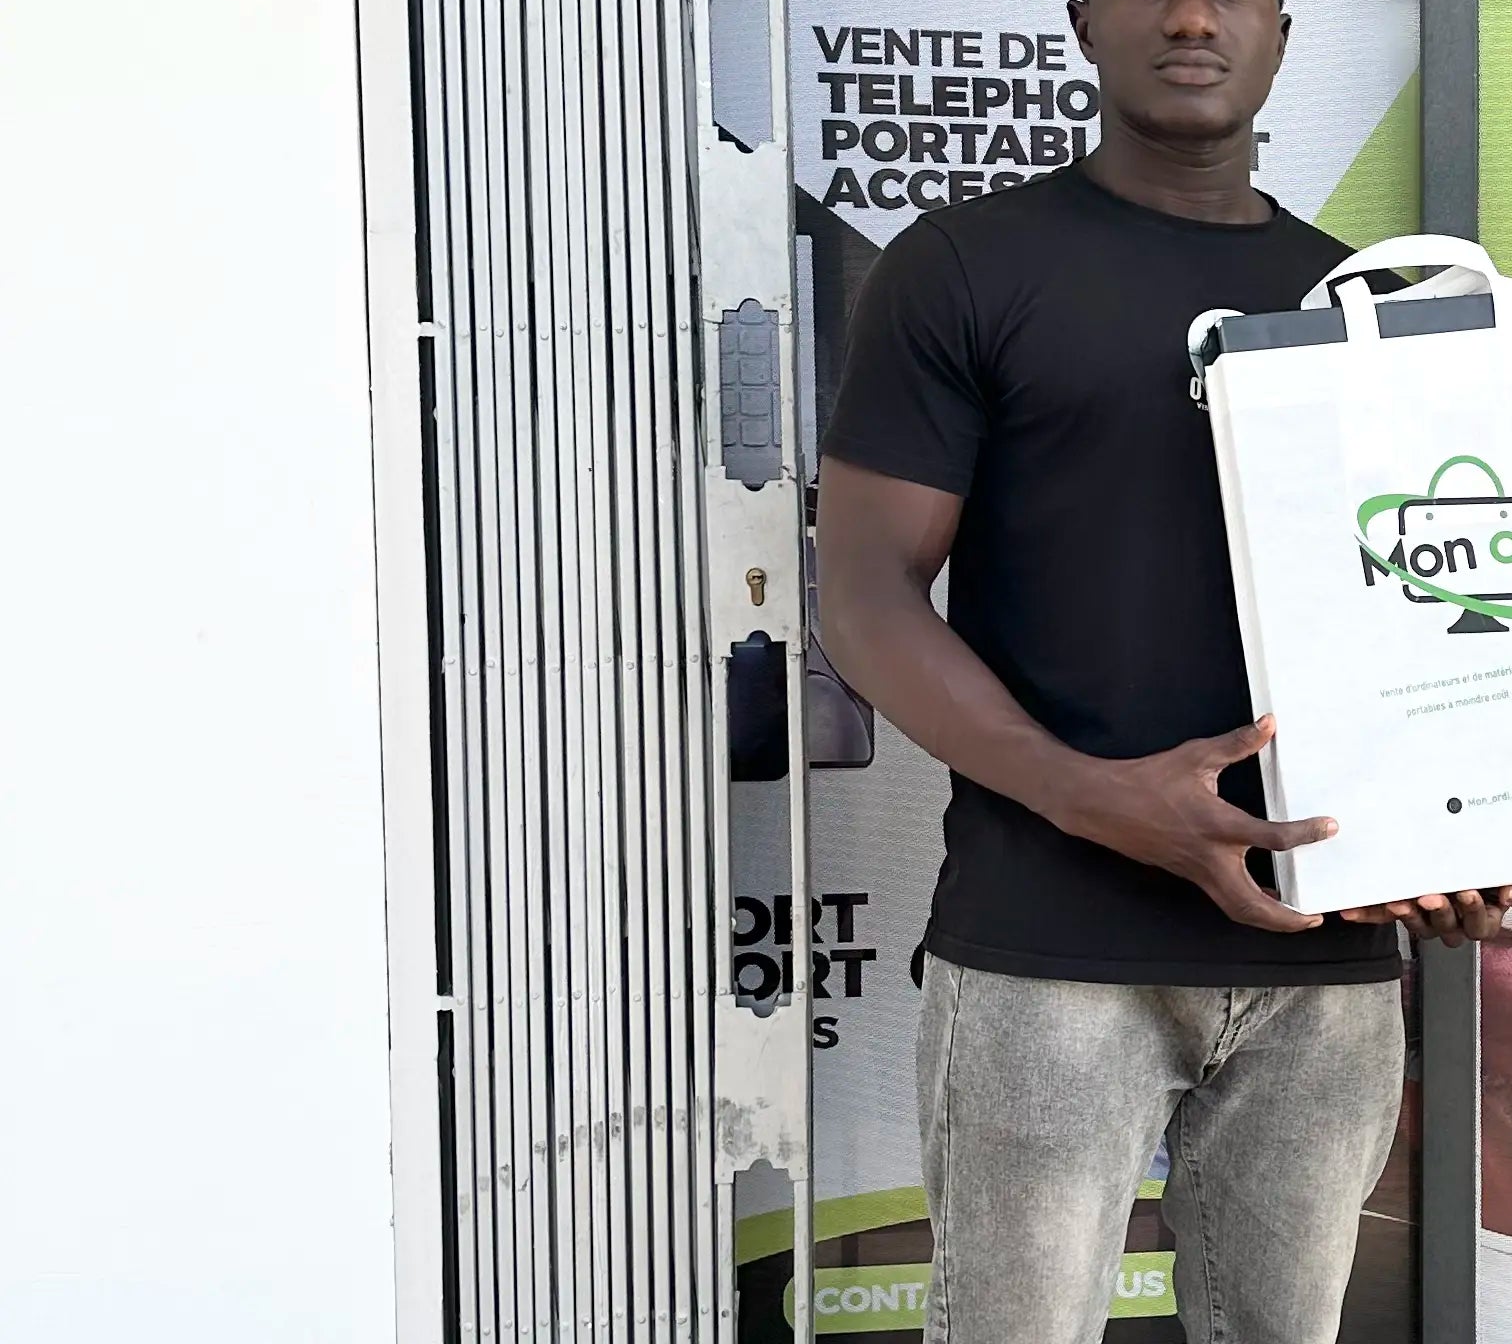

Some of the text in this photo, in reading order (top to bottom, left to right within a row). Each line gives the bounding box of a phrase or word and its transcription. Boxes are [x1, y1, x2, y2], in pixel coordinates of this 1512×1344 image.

[812, 25, 1067, 71] VENTE DE
[817, 72, 1100, 121] TELEPHO
[1359, 536, 1478, 587] Mon
[1380, 687, 1403, 698] Vente
[1462, 674, 1470, 684] et
[1472, 672, 1483, 682] de
[1406, 702, 1446, 718] portables
[1456, 694, 1490, 708] moindre
[734, 893, 868, 946] ORT
[734, 948, 877, 1000] ORT
[1115, 1270, 1167, 1298] US
